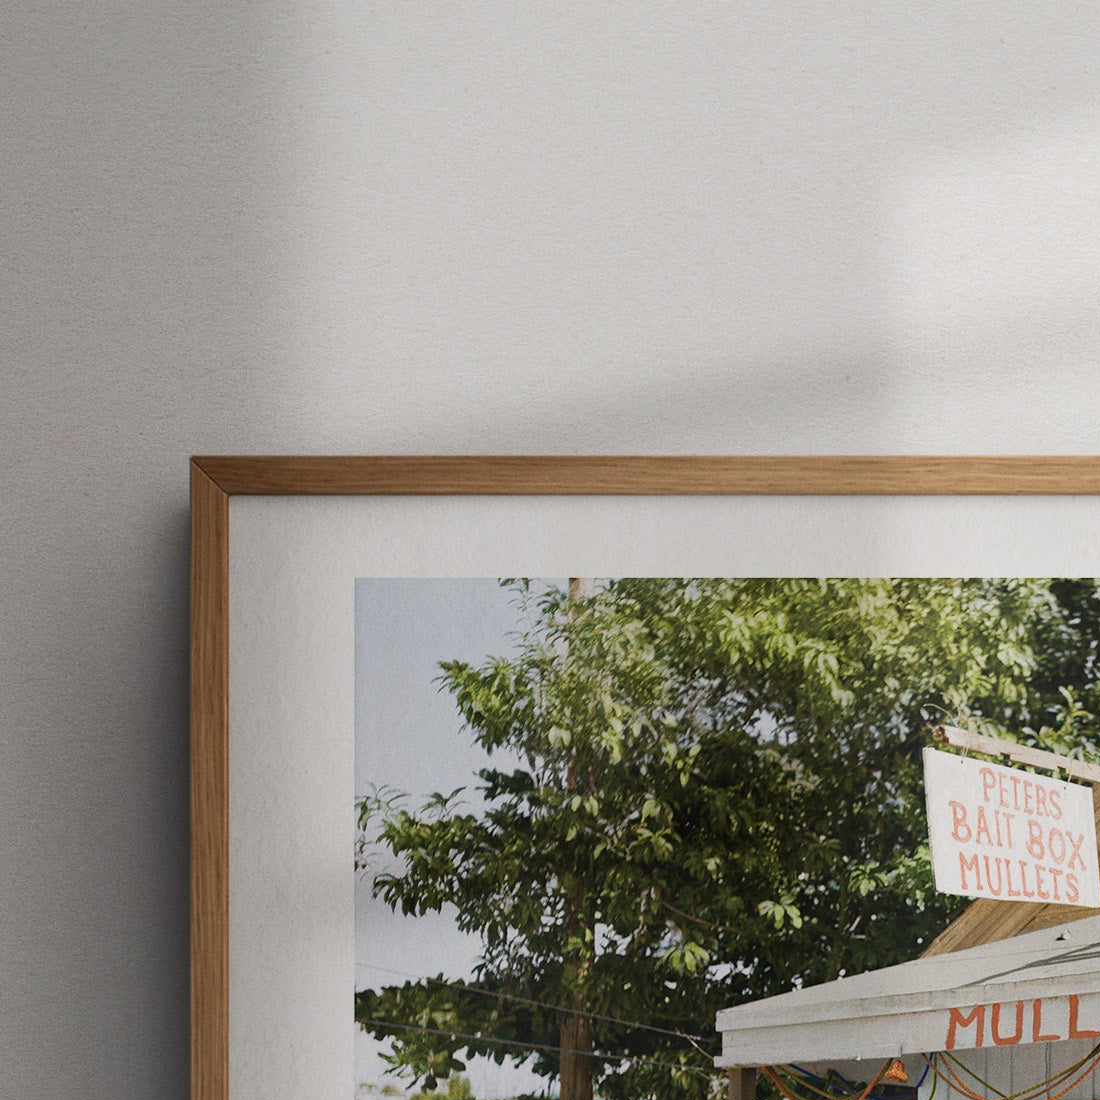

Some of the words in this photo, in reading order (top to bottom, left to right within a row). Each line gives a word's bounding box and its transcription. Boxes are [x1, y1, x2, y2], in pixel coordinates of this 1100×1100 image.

[978, 766, 1063, 820] PETERS
[948, 800, 1016, 850] BAIT
[1025, 819, 1088, 872] BOX
[958, 850, 1081, 903] MULLETS
